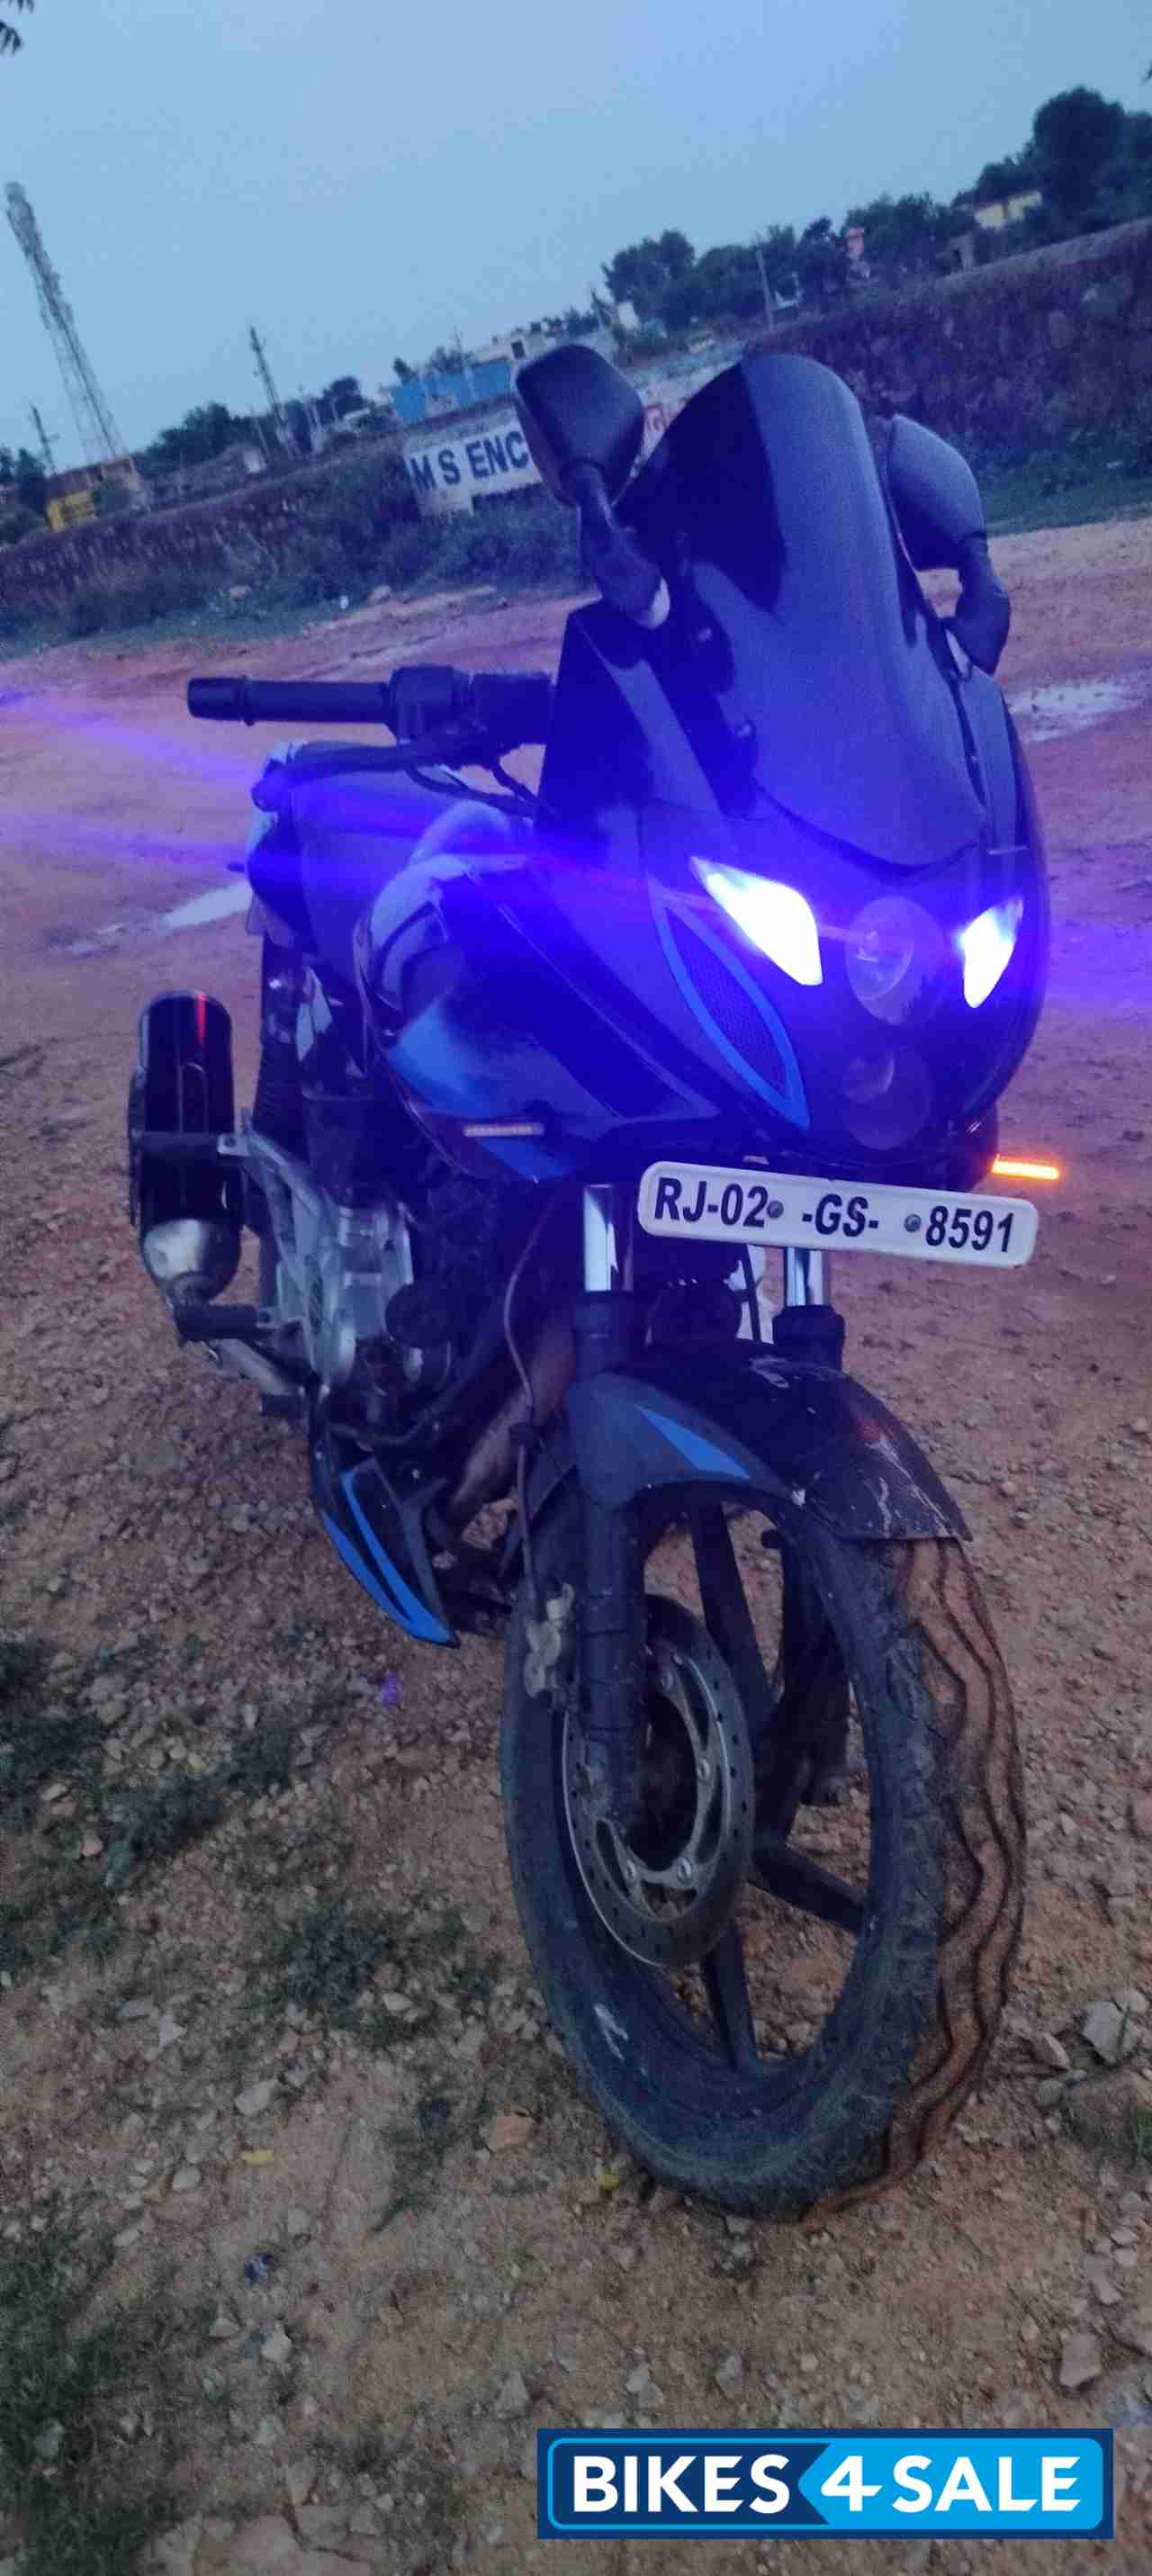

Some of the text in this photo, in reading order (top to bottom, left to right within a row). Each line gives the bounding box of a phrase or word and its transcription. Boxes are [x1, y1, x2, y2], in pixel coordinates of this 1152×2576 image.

[410, 454, 437, 491] M
[437, 448, 461, 485] S
[653, 1176, 770, 1229] RJ-02
[924, 1204, 1015, 1253] 8591
